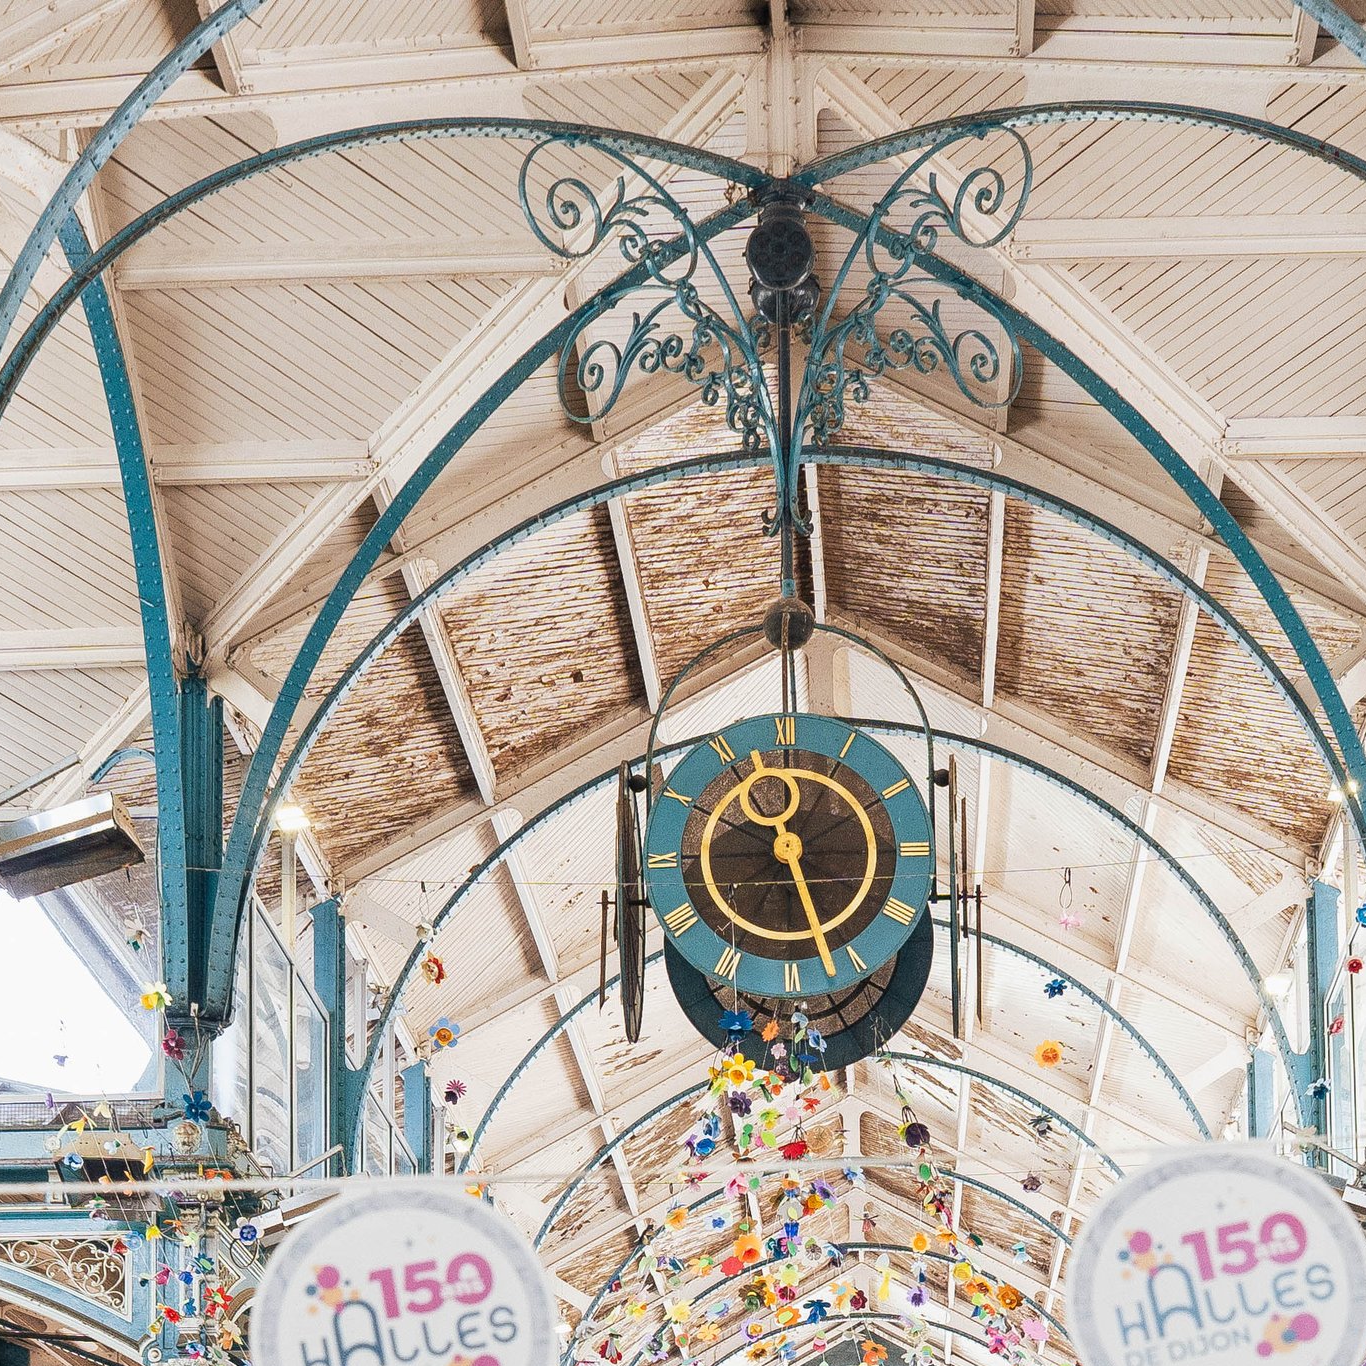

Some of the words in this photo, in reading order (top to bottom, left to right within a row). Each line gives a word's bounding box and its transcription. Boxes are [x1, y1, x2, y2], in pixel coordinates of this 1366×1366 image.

[1181, 1212, 1307, 1281] 150
[369, 1253, 493, 1319] 150
[1116, 1263, 1335, 1345] HALLES
[1167, 1328, 1252, 1361] DIJON
